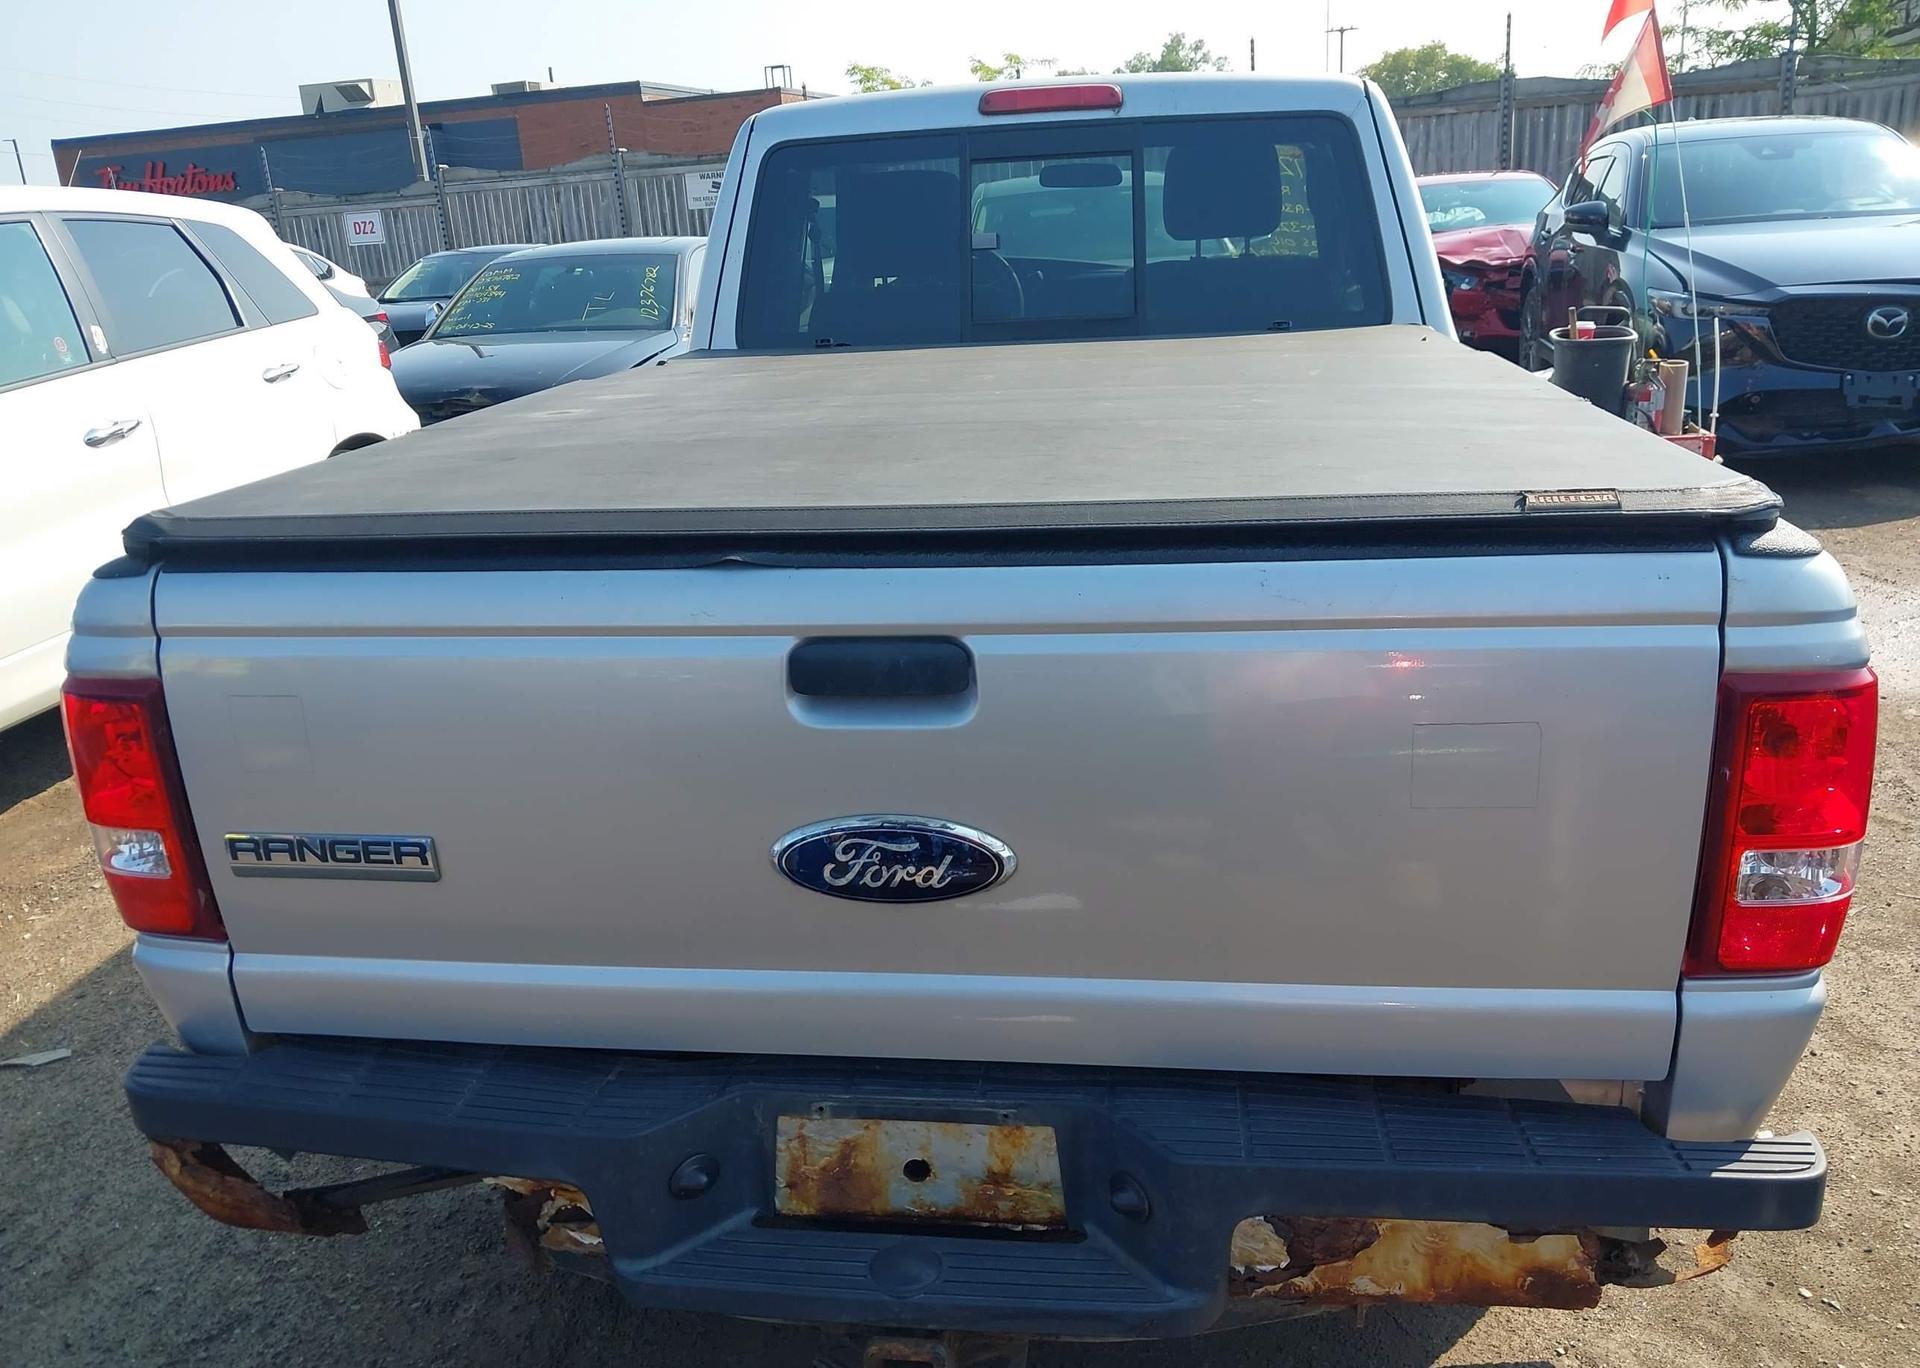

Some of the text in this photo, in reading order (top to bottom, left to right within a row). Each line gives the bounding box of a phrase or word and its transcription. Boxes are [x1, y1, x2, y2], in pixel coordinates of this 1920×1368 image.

[144, 160, 236, 195] Hortons
[699, 171, 725, 180] WARNI
[353, 220, 376, 235] DZ2
[640, 265, 660, 320] 12376782
[228, 837, 430, 867] RANGER
[822, 838, 953, 888] Ford
